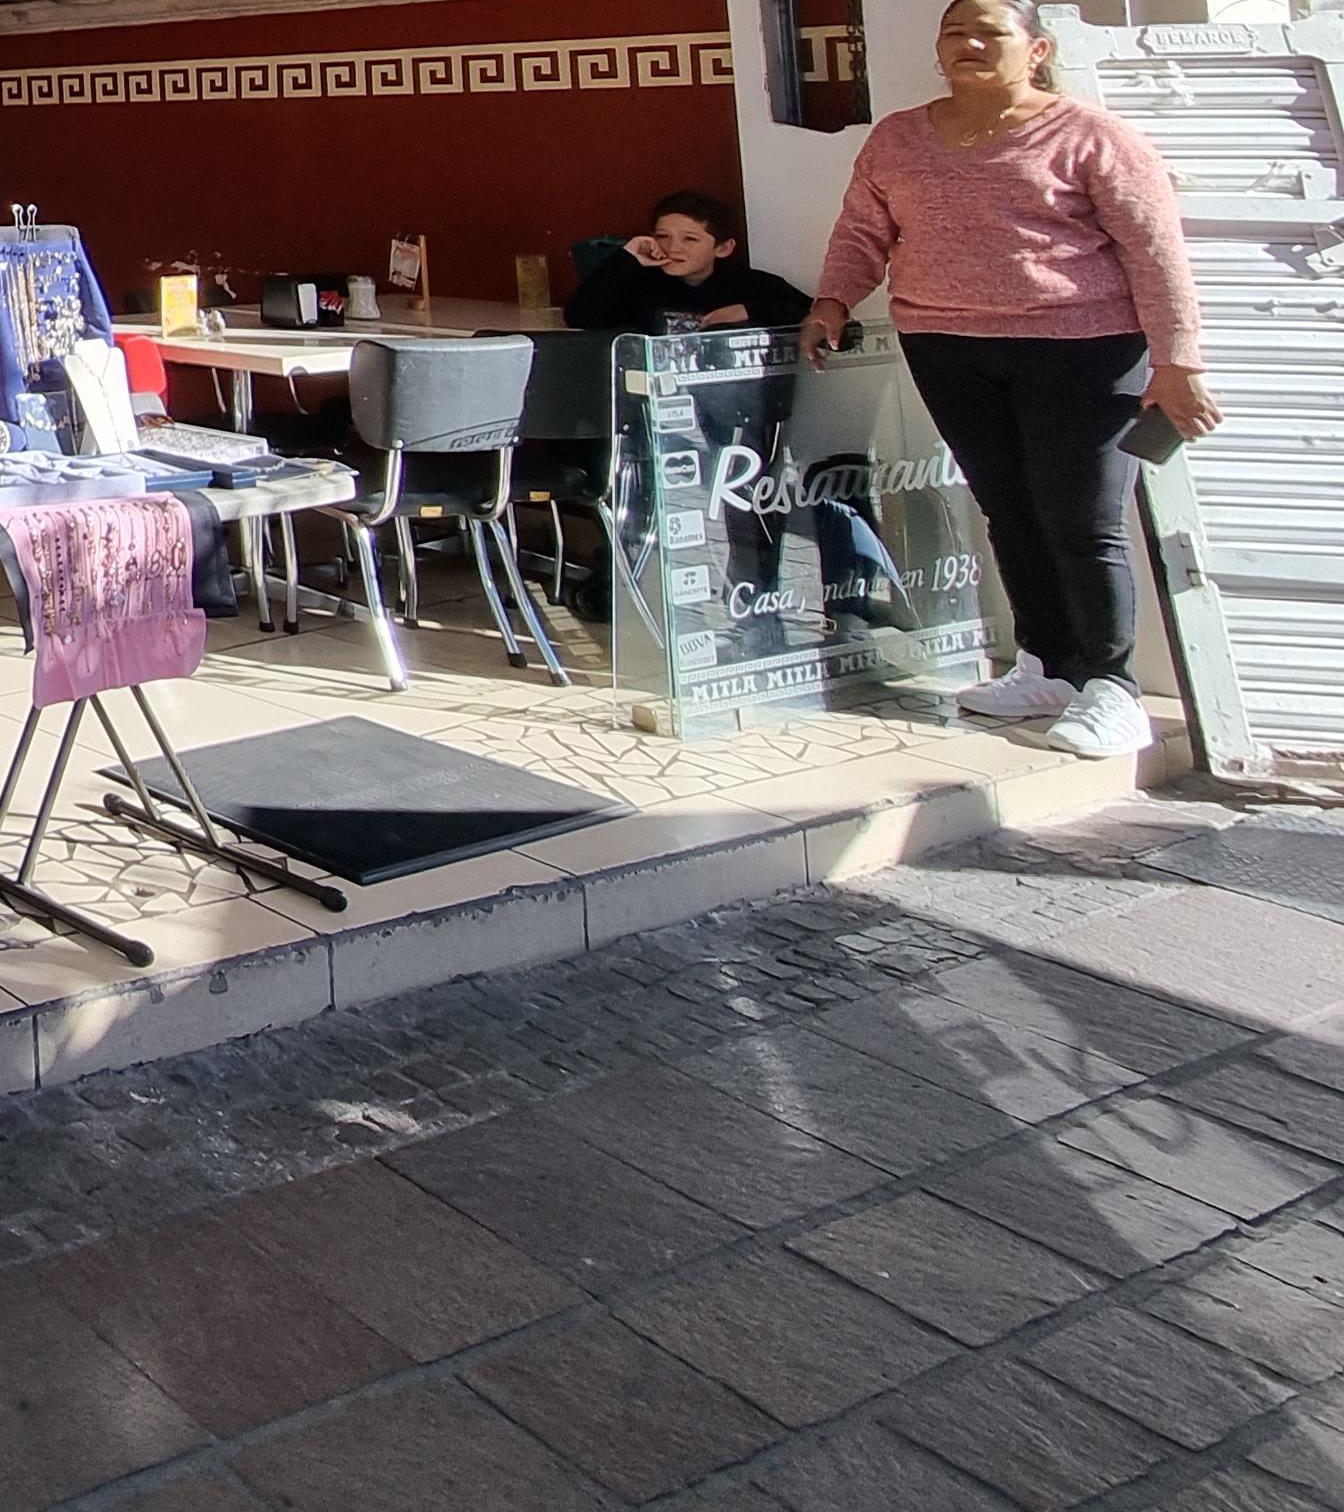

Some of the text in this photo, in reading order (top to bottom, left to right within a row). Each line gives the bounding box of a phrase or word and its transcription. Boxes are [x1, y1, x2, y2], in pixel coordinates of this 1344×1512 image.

[666, 408, 685, 418] VISA
[709, 441, 969, 520] Restaurant
[729, 581, 794, 619] Casa
[899, 567, 925, 589] en
[931, 553, 983, 592] 1938
[679, 633, 713, 656] BBVA
[691, 675, 758, 704] MITLA
[766, 660, 830, 690] MITLA
